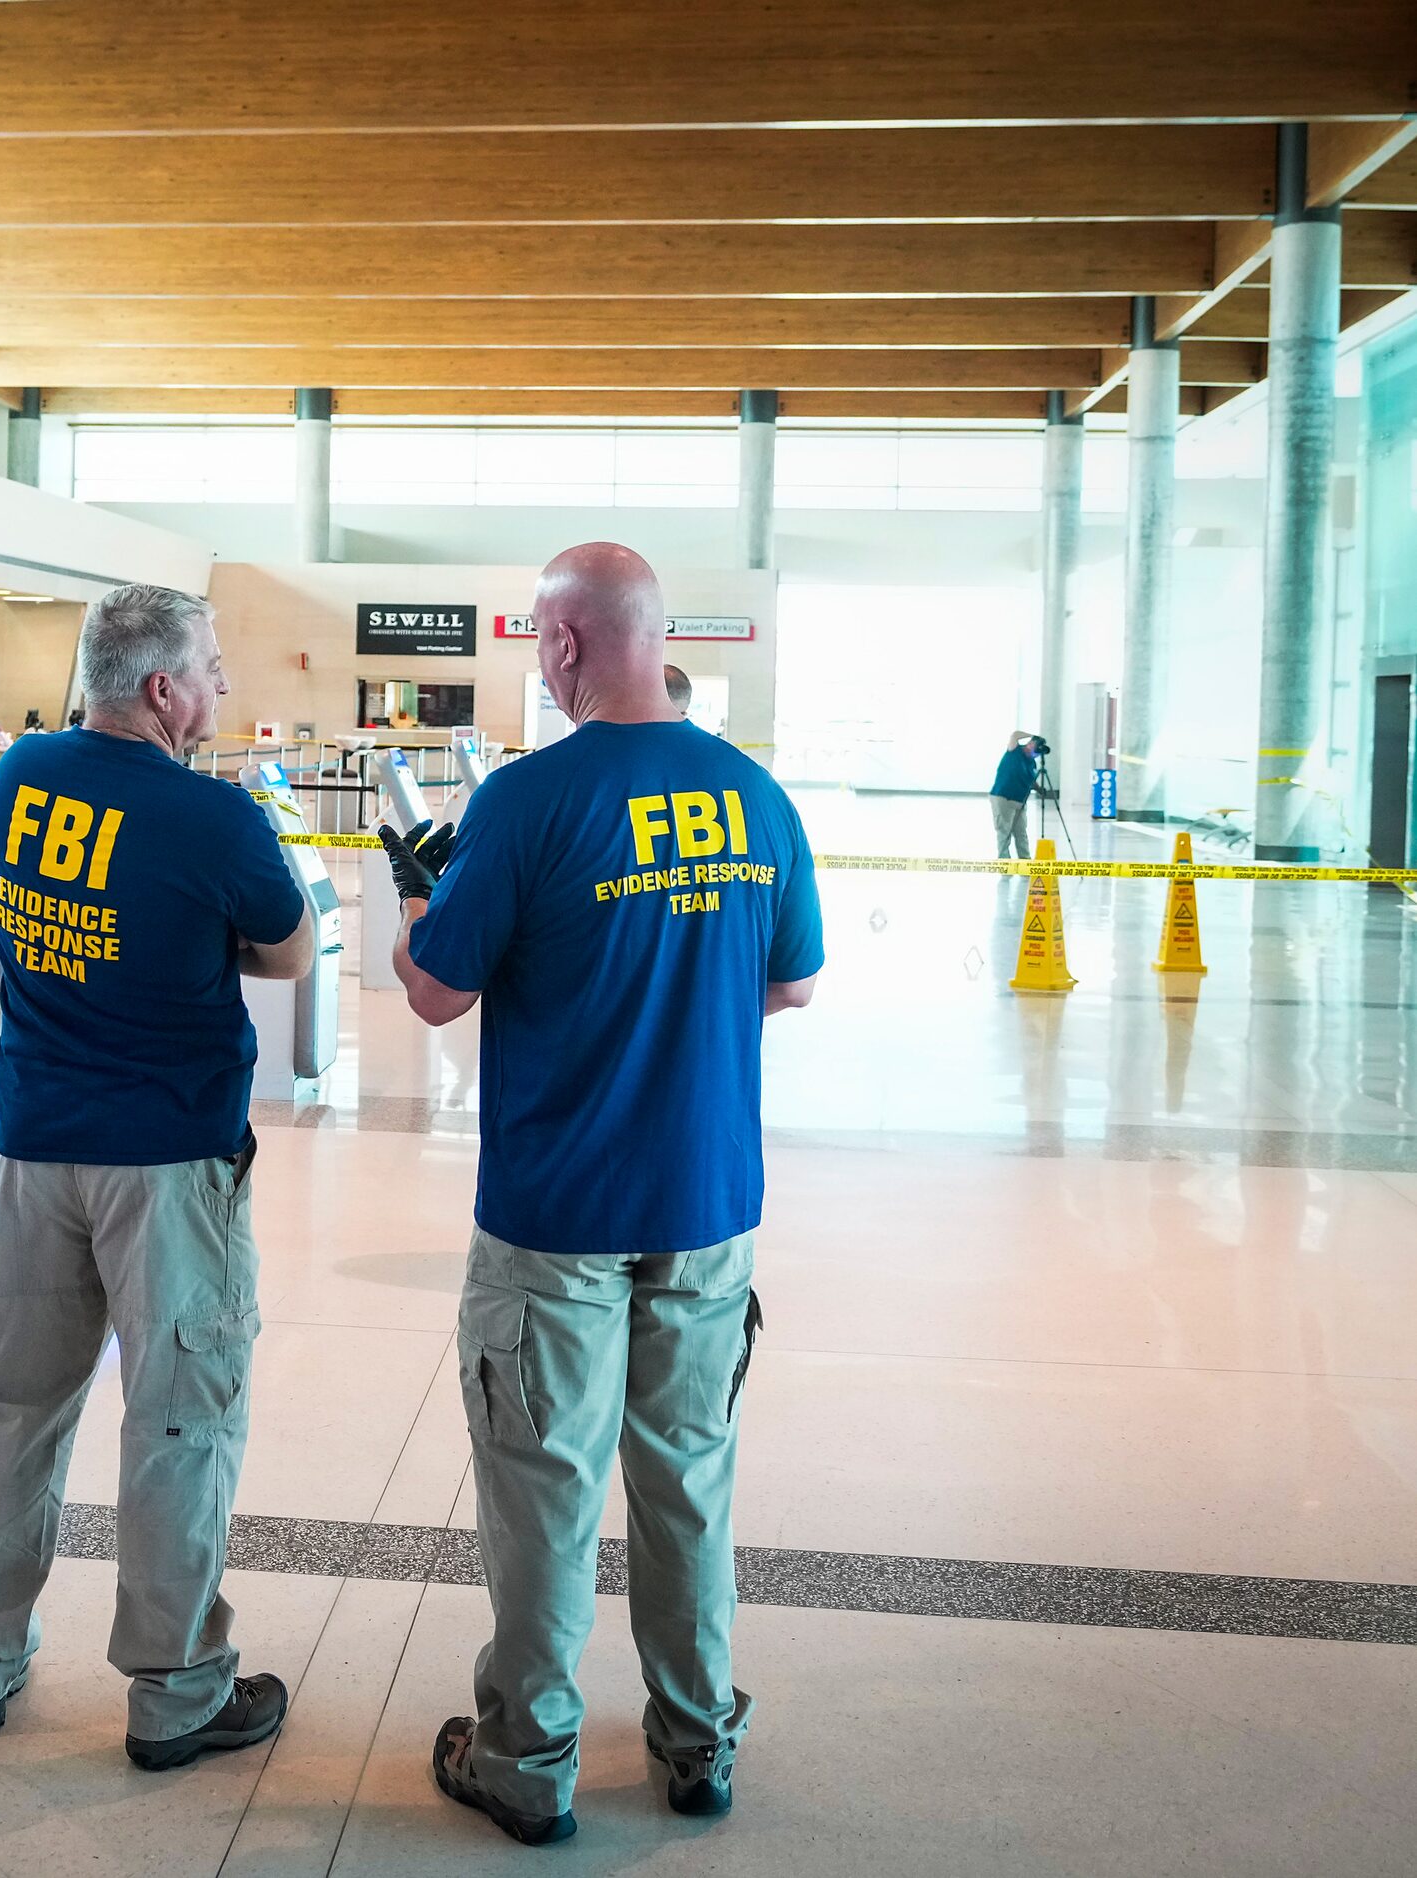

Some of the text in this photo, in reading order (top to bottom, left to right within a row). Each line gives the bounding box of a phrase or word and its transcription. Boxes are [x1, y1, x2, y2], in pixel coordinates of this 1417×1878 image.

[369, 611, 464, 627] SEWELL
[678, 623, 745, 635] Valet Parking
[5, 784, 125, 891] FBI
[628, 789, 748, 866] FBI
[595, 866, 691, 902] EVIDENCE
[669, 891, 720, 915] TEAM
[0, 875, 118, 934] EVIDENCE
[13, 939, 86, 984] TEAM
